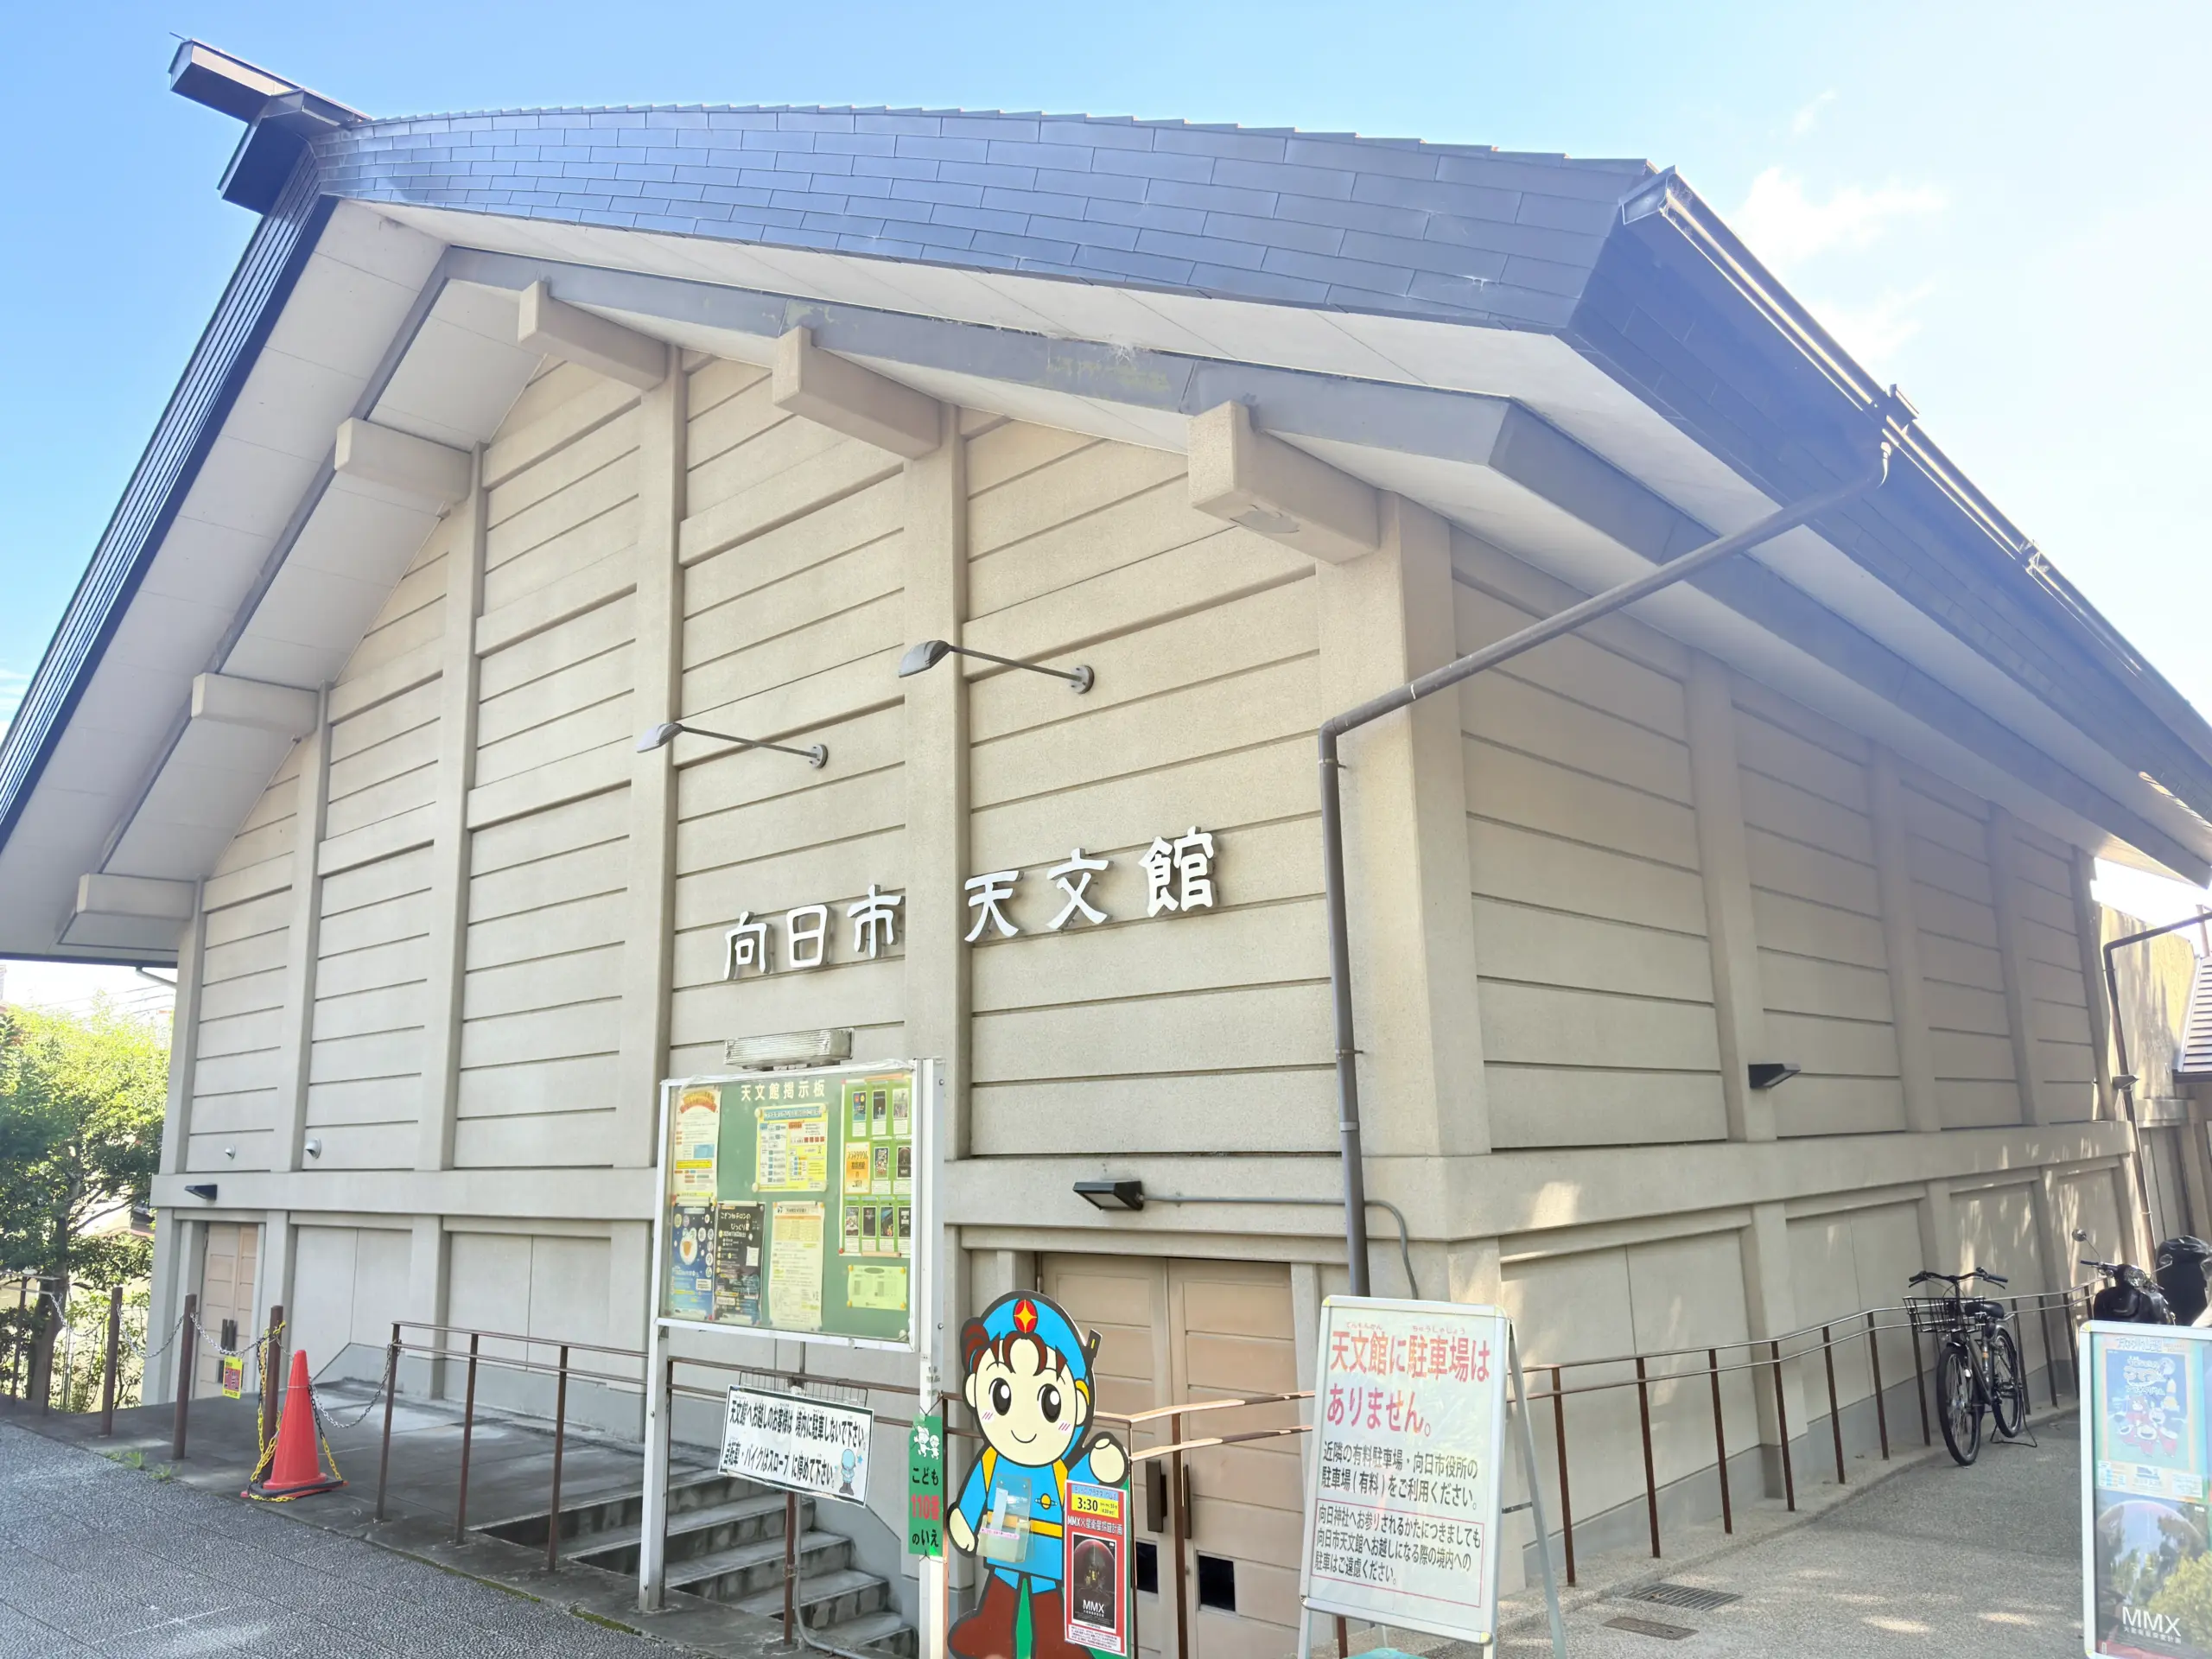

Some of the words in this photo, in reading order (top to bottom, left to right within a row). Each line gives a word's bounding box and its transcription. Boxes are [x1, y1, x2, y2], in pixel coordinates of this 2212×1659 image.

[723, 884, 905, 981] 向日市
[963, 825, 1216, 943] 天文館
[741, 1079, 825, 1102] 天文館掲示板
[1330, 1330, 1491, 1383] 天文館に駐車場は
[1327, 1382, 1432, 1438] ありません。
[912, 1466, 939, 1486] こども
[911, 1493, 941, 1521] 110番
[1077, 1497, 1098, 1512] 3:30
[912, 1529, 939, 1548] のいえ
[1318, 1504, 1481, 1549] 向日神社へお参りされるかたにつきましても
[1316, 1528, 1471, 1573] 向日市天文館へお越しになる際の境内への
[1314, 1551, 1397, 1586] 駐車はご遠慮ください。
[1083, 1599, 1105, 1614] MMX
[2122, 1606, 2182, 1637] MMX
